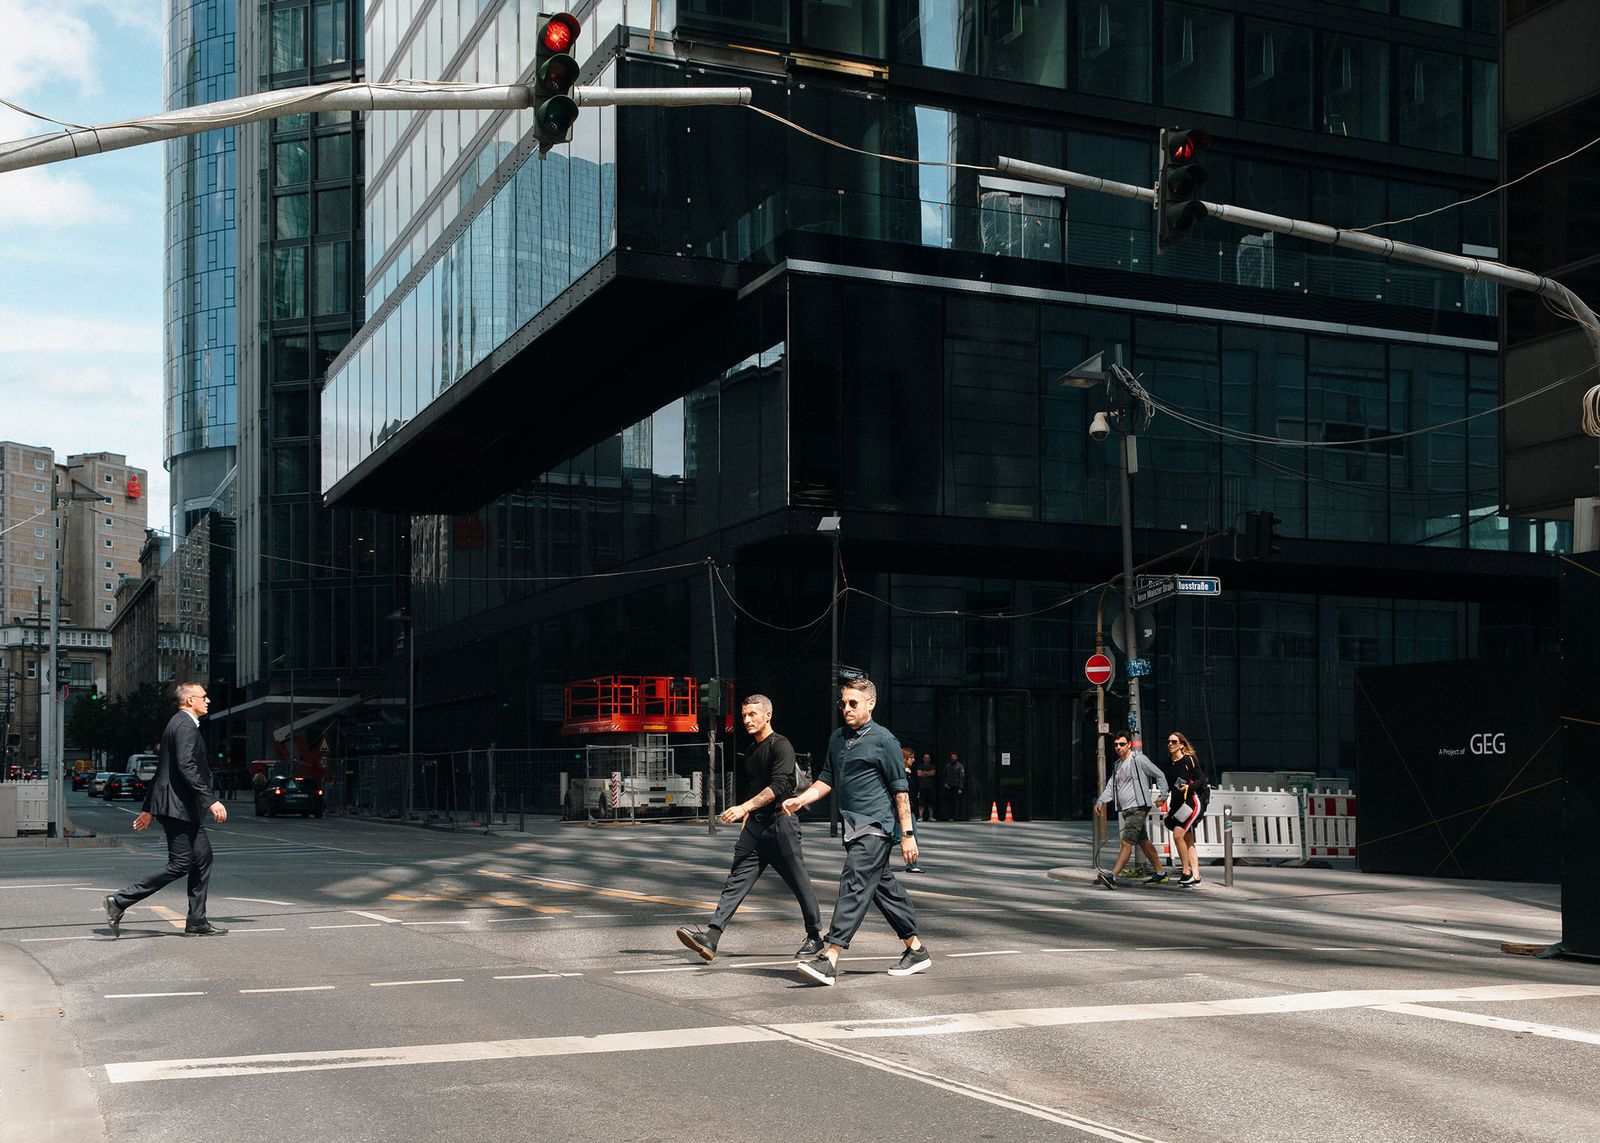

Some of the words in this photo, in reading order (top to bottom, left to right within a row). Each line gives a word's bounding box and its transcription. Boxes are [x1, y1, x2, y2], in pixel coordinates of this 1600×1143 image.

[1178, 581, 1209, 591] lusstraße
[1443, 748, 1459, 756] Project
[1460, 747, 1466, 755] of
[1470, 733, 1506, 755] GEG
